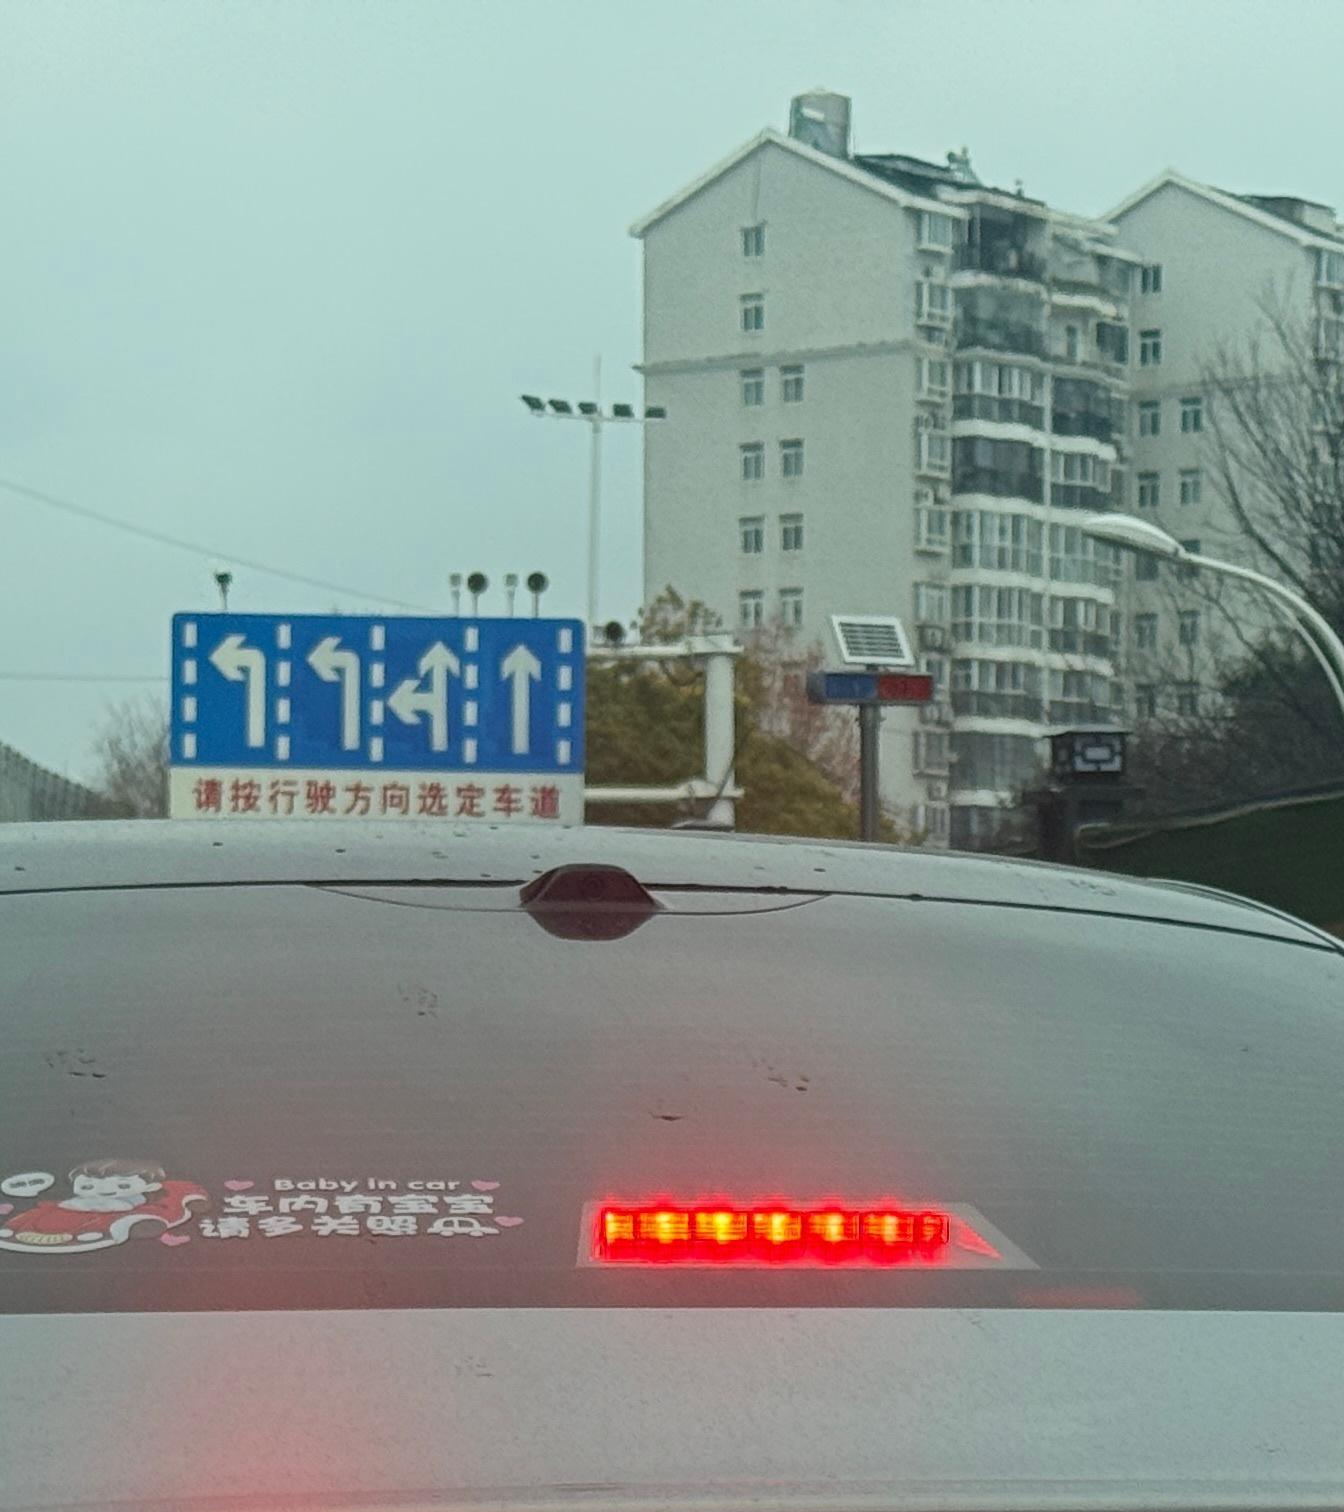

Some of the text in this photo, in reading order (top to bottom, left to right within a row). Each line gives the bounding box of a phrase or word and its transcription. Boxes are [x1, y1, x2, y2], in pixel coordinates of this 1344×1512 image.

[193, 778, 561, 820] 请按行驶方向选定车道
[274, 1178, 358, 1192] Baby
[408, 1180, 460, 1190] car
[223, 1195, 494, 1215] 车内有宝宝
[199, 1215, 418, 1239] 请多关照
